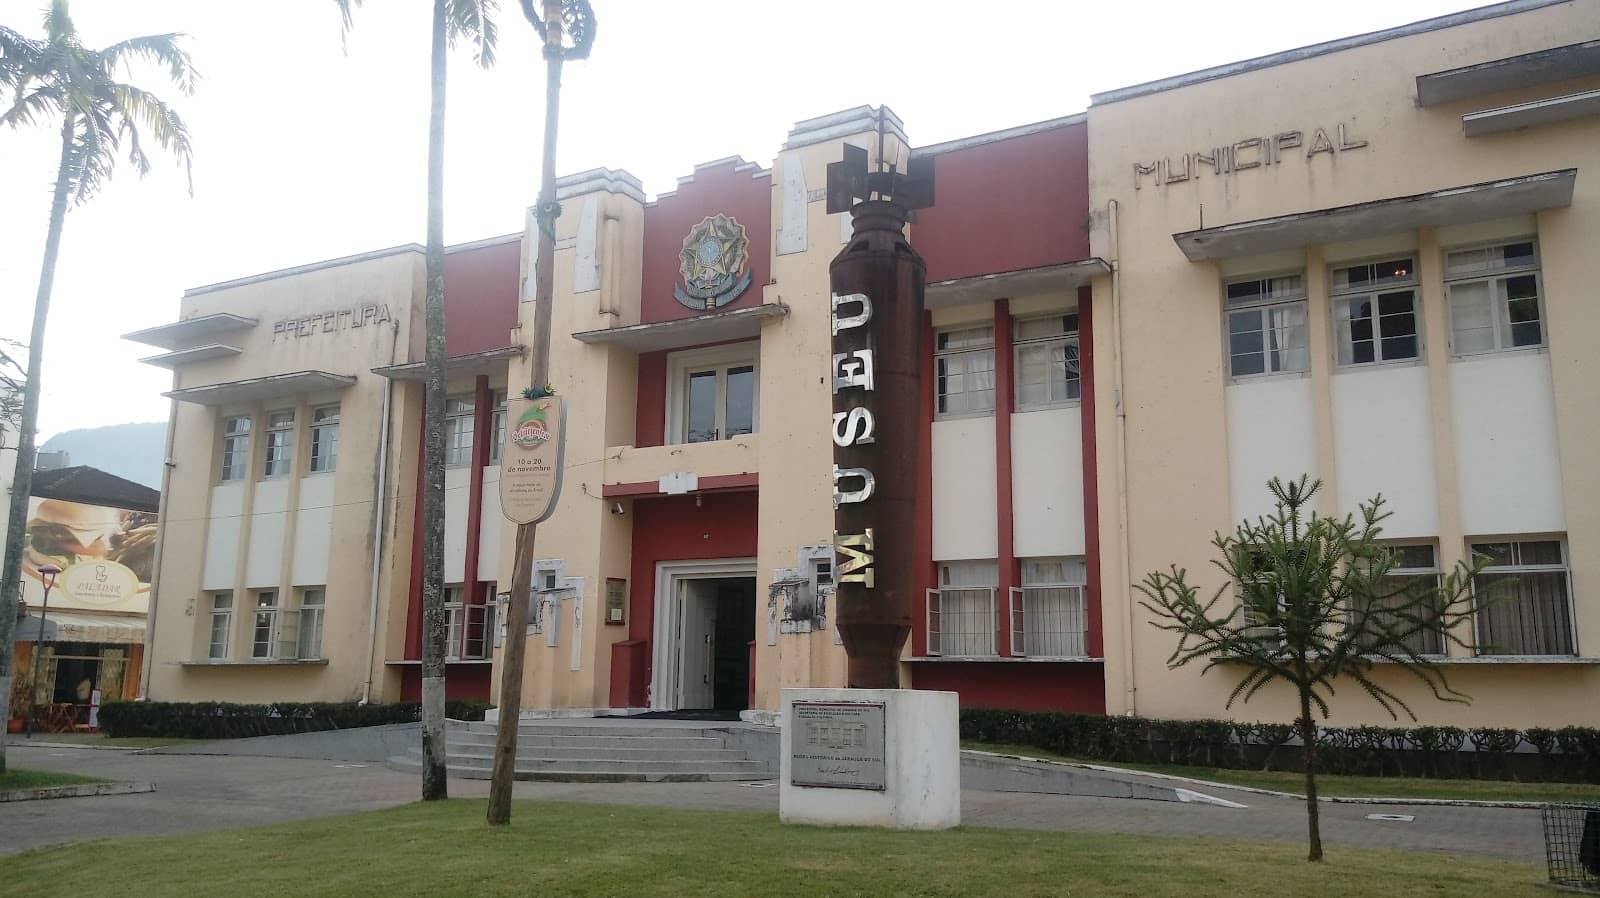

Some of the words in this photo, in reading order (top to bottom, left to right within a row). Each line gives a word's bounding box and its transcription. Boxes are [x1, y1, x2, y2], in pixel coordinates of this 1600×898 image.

[1133, 123, 1369, 191] MUNICIPAL
[271, 303, 392, 343] PREFEITURA
[832, 292, 876, 589] MUSEU
[517, 464, 551, 472] novembro
